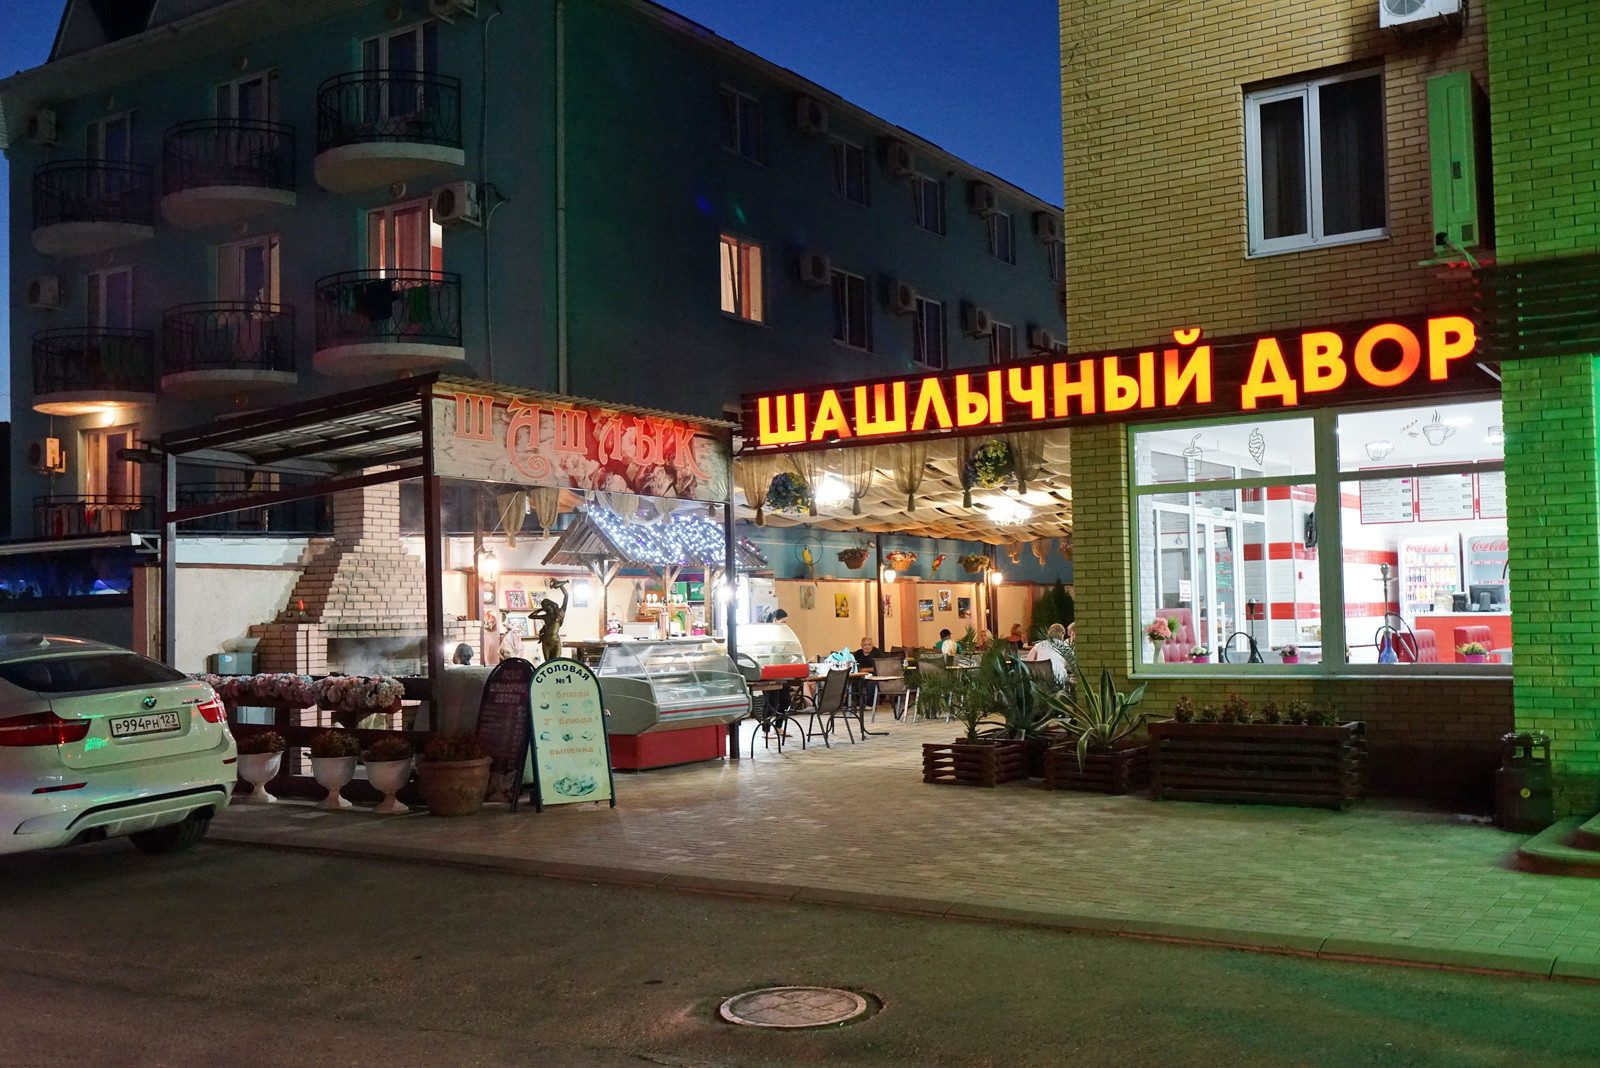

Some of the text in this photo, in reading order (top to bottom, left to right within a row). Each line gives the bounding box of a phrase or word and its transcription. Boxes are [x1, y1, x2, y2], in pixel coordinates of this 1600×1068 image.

[758, 315, 1477, 446] ШАШЛЫЧНЫЙ ДВОР
[453, 391, 713, 481] ШАШЛЫК
[535, 664, 590, 684] СТОЛОВАЯ
[555, 690, 590, 699] блюда
[559, 717, 593, 725] блюда
[549, 746, 594, 755] выпечка
